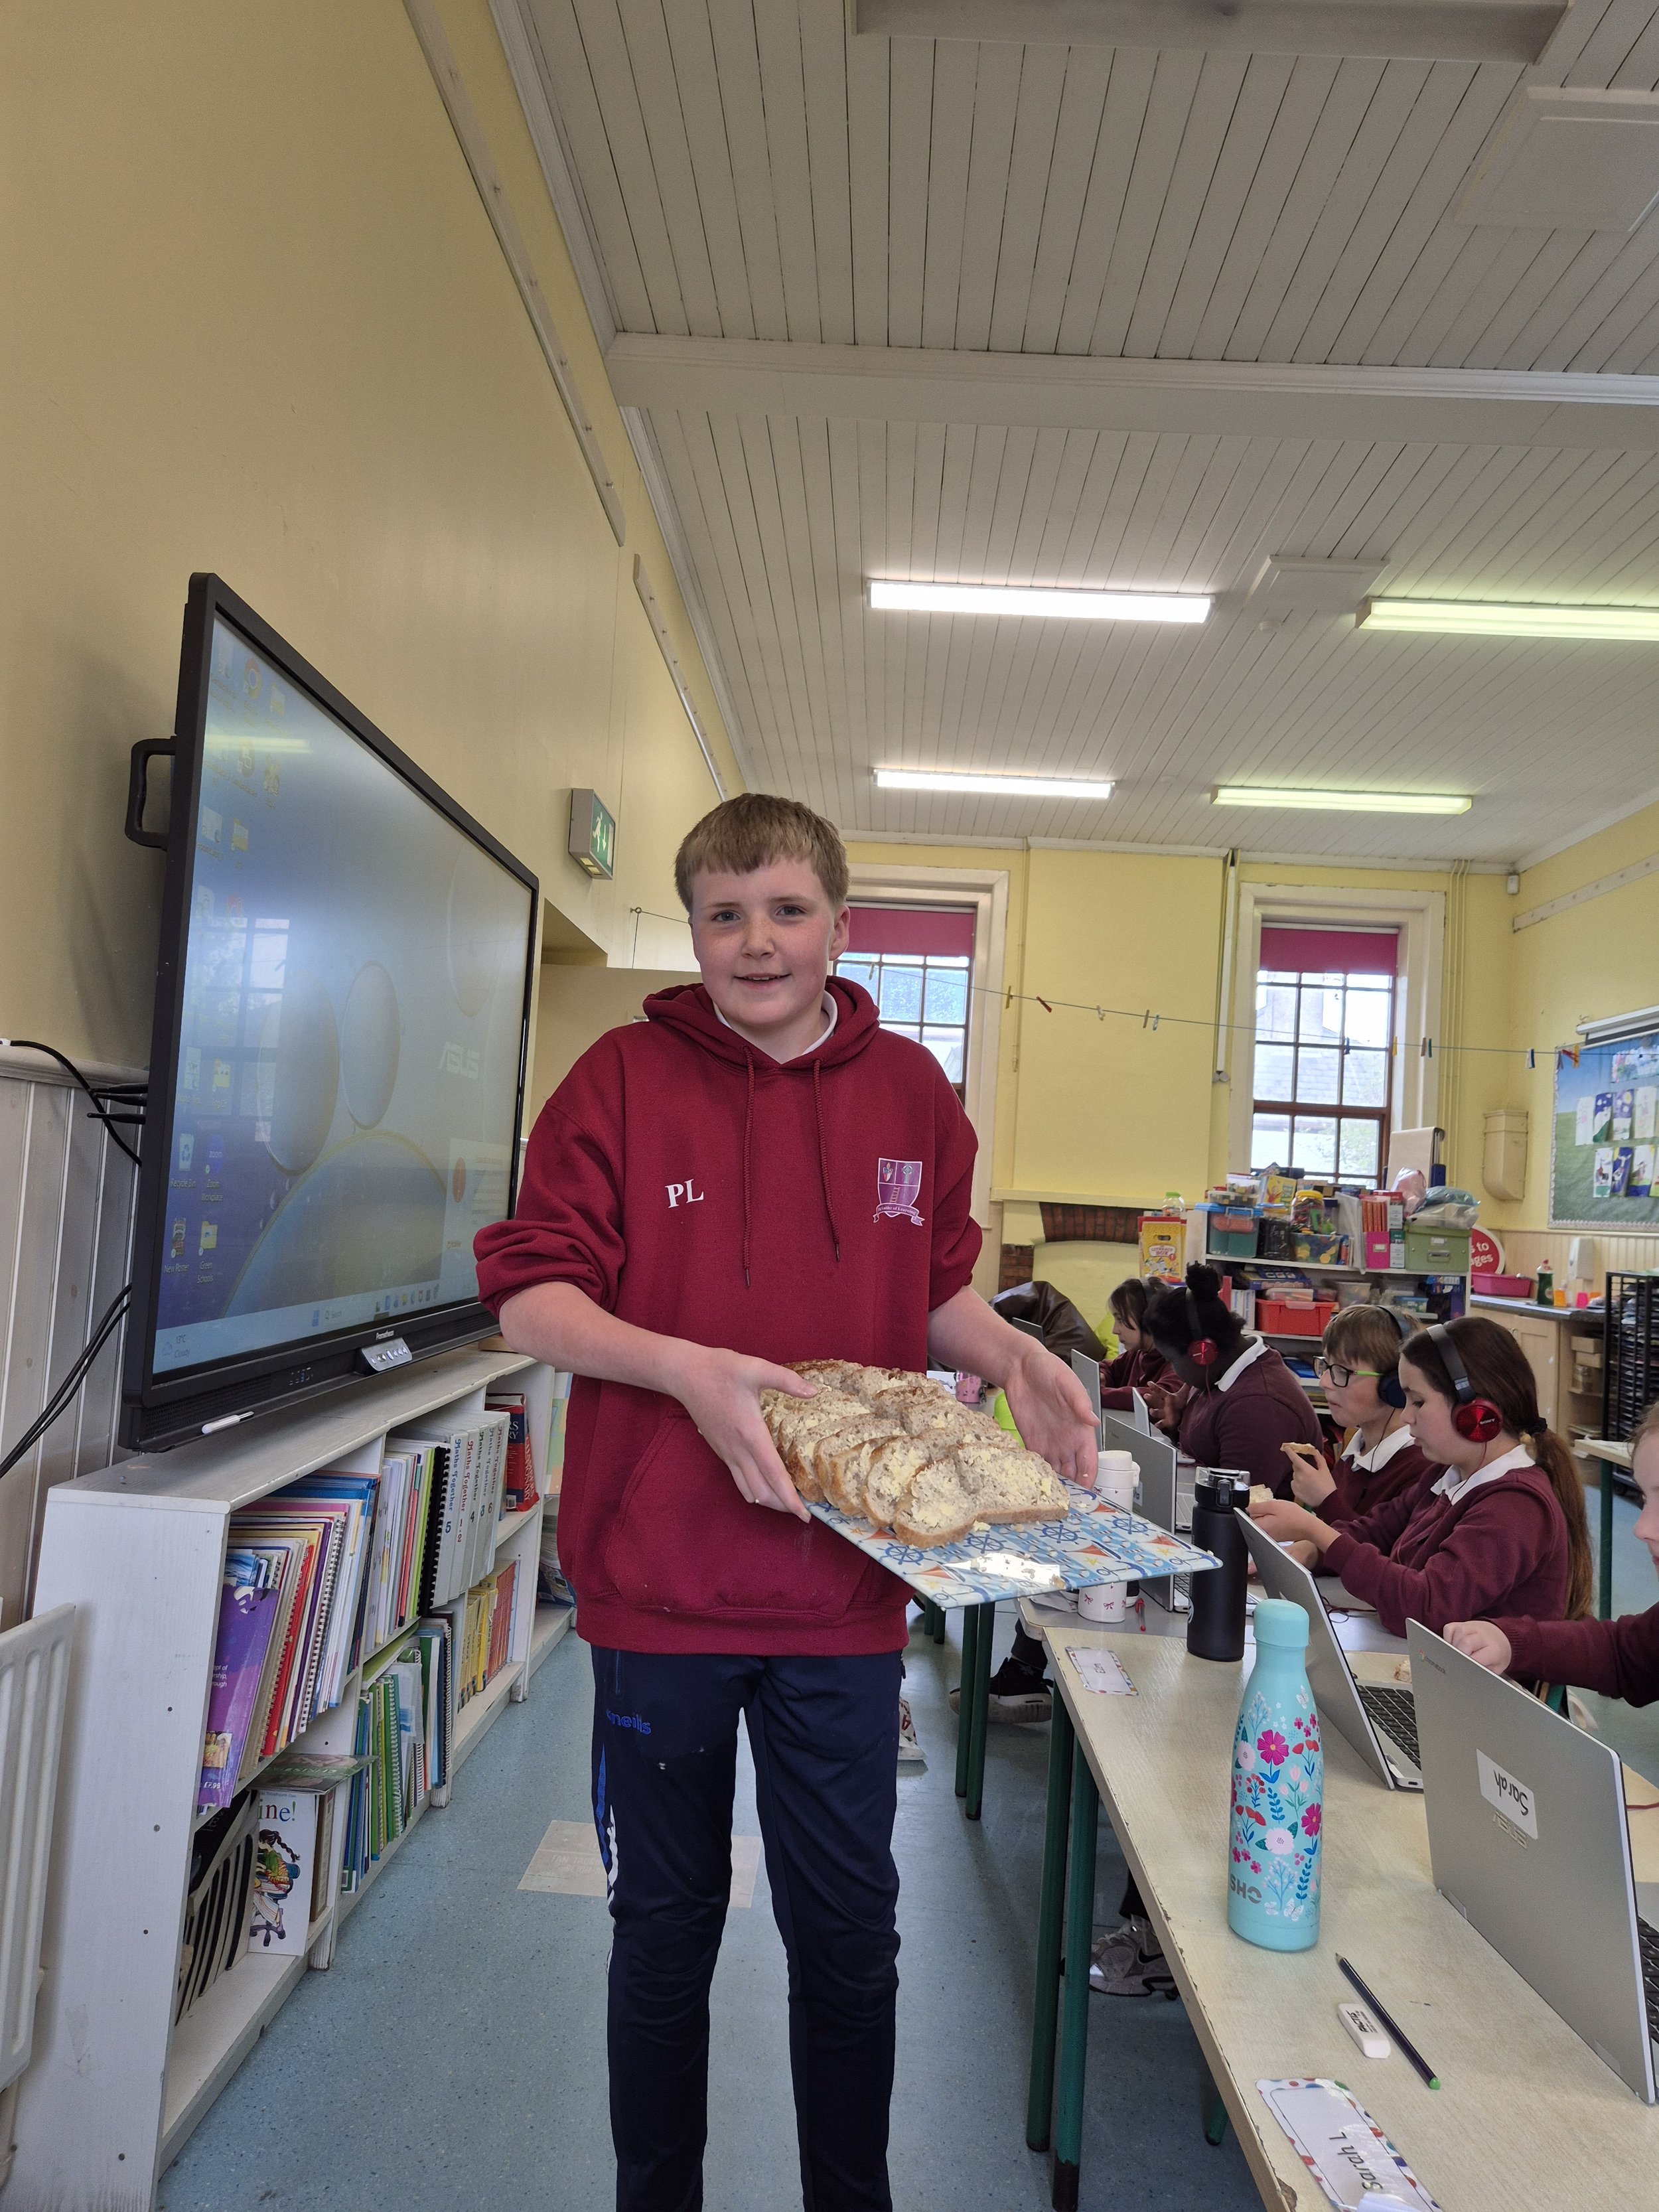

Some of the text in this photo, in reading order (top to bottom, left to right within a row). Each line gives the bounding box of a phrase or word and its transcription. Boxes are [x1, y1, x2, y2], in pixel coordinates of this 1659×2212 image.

[171, 1177, 187, 1189] Recycle
[206, 1179, 220, 1188] Zoom
[664, 1179, 704, 1208] PL
[1476, 1242, 1489, 1252] to
[164, 1263, 189, 1273] New Poster
[200, 1261, 212, 1270] Green
[197, 1275, 213, 1284] Schools
[472, 1462, 482, 1502] Together
[491, 1456, 500, 1494] Together
[448, 1471, 459, 1511] Together
[461, 1473, 470, 1512] Together
[470, 1511, 475, 1522] 4
[488, 1503, 493, 1513] 6
[445, 1521, 451, 1533] 5
[1494, 1771, 1528, 1816] Sarah
[1493, 1812, 1527, 1849] ASUS
[1230, 1873, 1262, 1903] SHO
[1329, 2131, 1384, 2189] Sarah L
